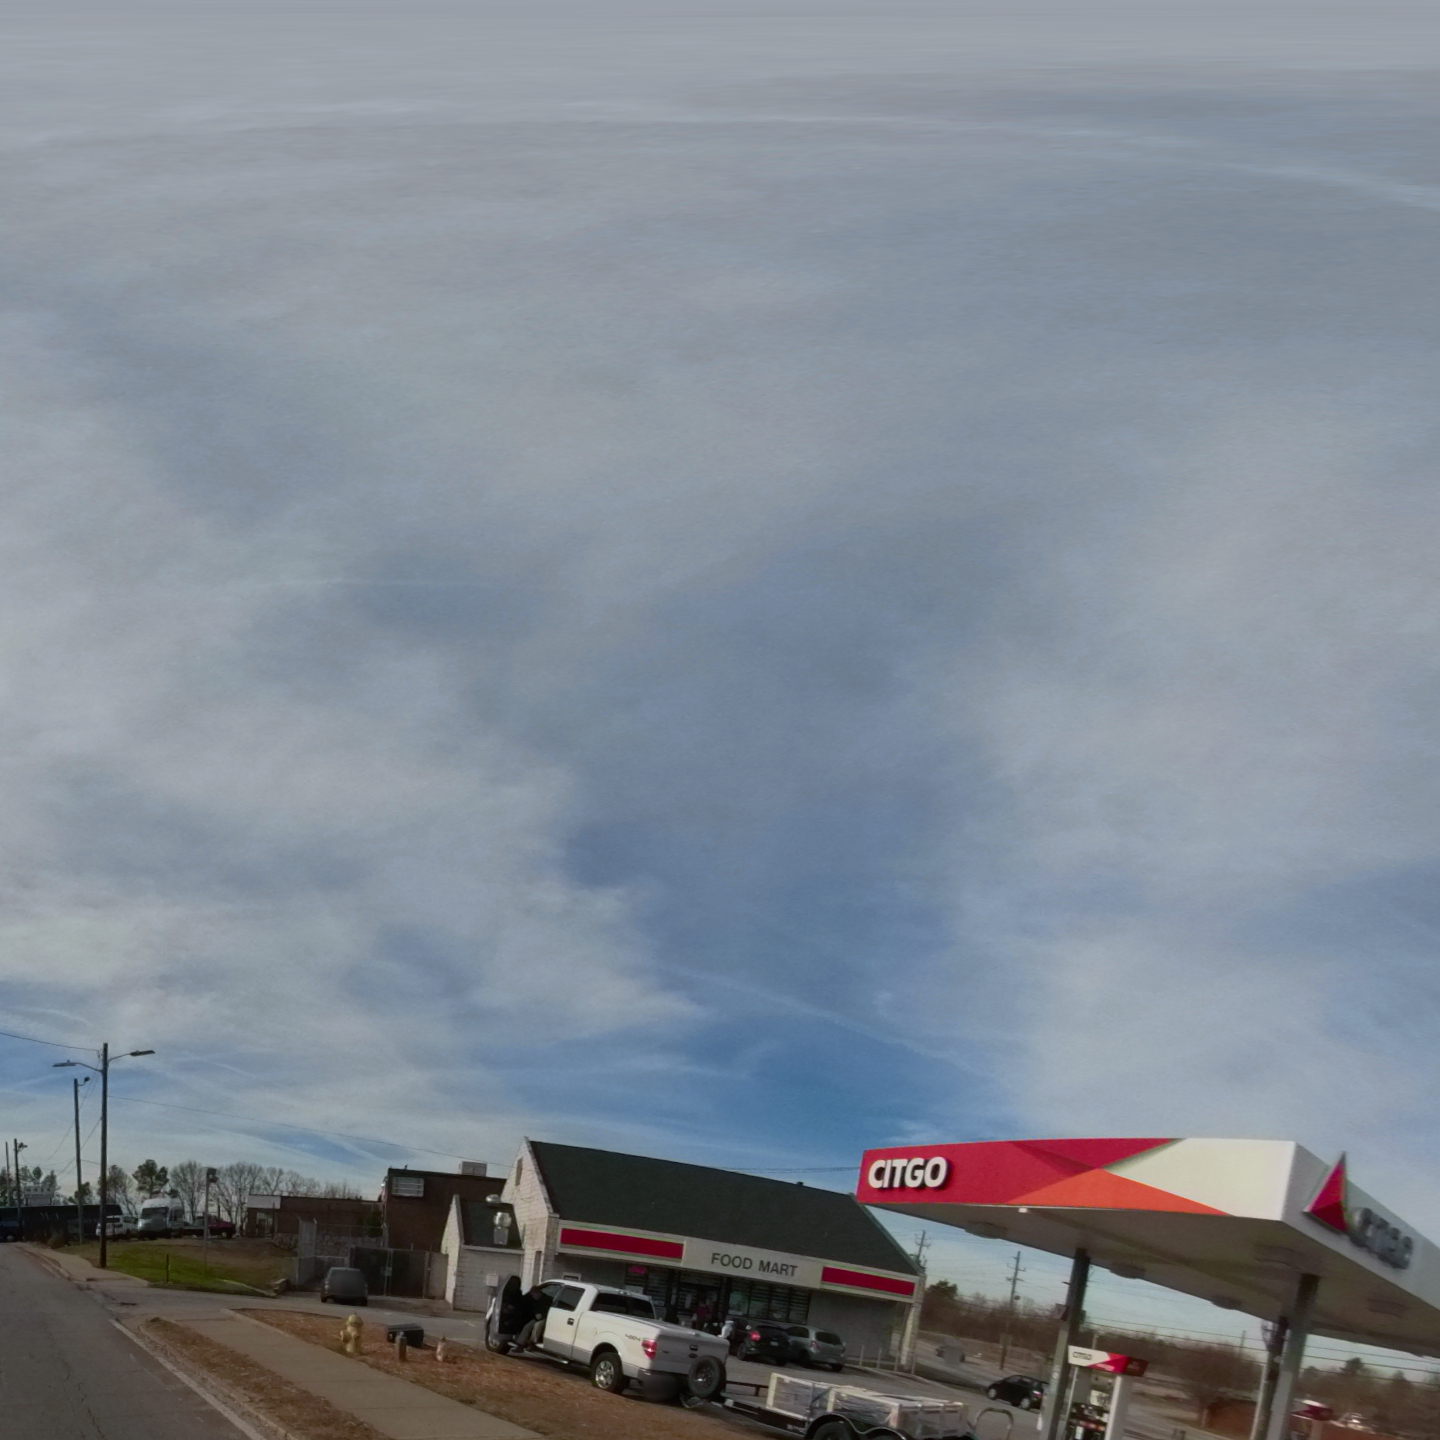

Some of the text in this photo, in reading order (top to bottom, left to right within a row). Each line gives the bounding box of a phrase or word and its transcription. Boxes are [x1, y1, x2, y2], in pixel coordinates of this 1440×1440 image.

[868, 1156, 948, 1189] CITGO
[711, 1252, 799, 1278] FOOD MART
